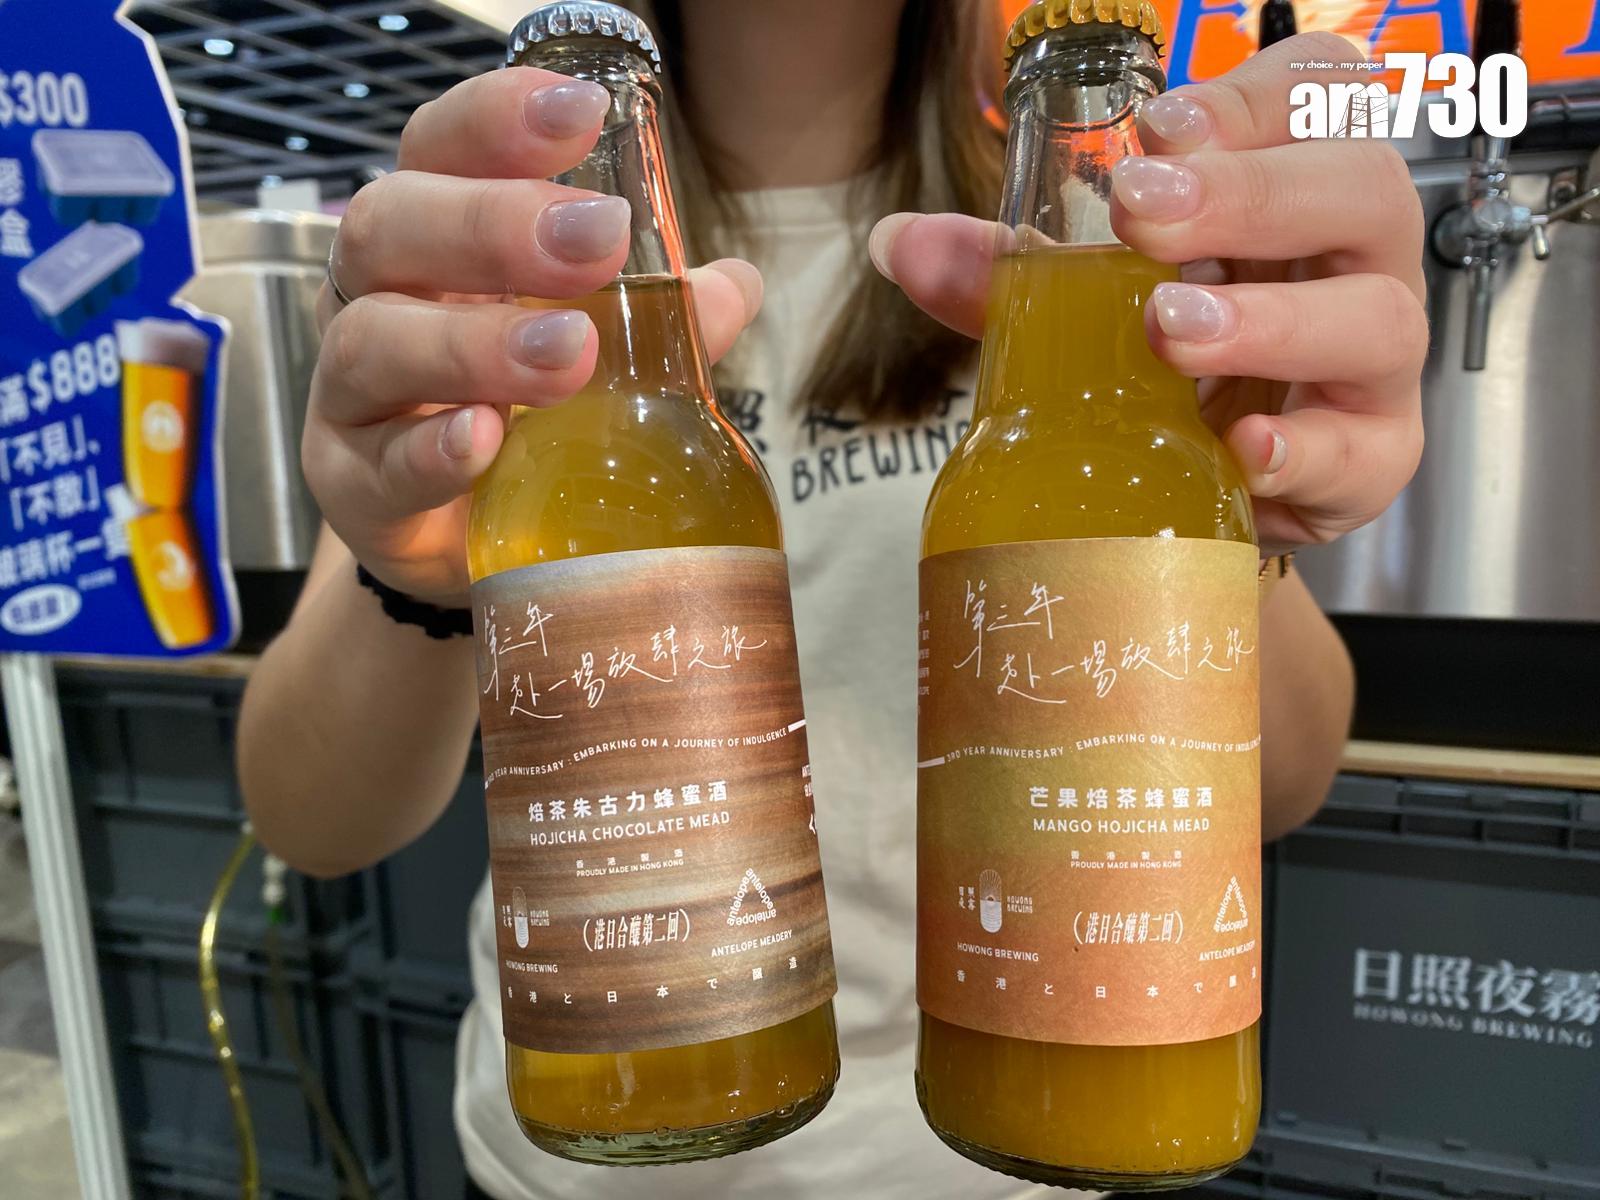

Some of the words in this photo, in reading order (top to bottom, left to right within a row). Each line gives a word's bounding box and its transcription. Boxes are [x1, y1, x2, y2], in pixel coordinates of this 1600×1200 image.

[509, 760, 564, 776] ANNIVERSARY
[574, 738, 636, 762] EMBARKING
[641, 738, 657, 748] ON
[662, 738, 669, 748] A
[674, 738, 724, 748] JOURNEY
[727, 737, 740, 748] OF
[743, 727, 787, 746] INDULGENCE
[963, 746, 986, 756] YEAR
[989, 747, 1063, 759] ANNIVERSARY
[1076, 733, 1145, 750] EMBARKING
[1151, 734, 1165, 744] ON
[1169, 738, 1177, 746] A
[1181, 739, 1221, 752] JOURNEY
[1225, 743, 1234, 752] OF
[528, 780, 728, 823] 焙茶朱古力蜂蜜酒
[1029, 786, 1212, 809] 芒果焙茶蜂蜜酒
[530, 830, 587, 846] HOJICHA
[592, 818, 684, 841] CHOCOLATE
[690, 811, 730, 828] MEAD
[1033, 818, 1091, 833] MANGO
[1098, 819, 1168, 833] HOJICHA
[1173, 818, 1209, 832] MEAD
[576, 867, 607, 878] PROUDLY
[608, 865, 629, 875] MADE
[630, 864, 639, 872] IN
[640, 862, 661, 871] HONG
[663, 858, 684, 868] KONG
[1107, 861, 1128, 869] MADE
[1140, 861, 1161, 869] HONG
[711, 939, 758, 957] ANTELOPE
[760, 929, 792, 947] MEADERY
[957, 942, 993, 955] HOWONG
[994, 948, 1039, 962] BREWING
[1199, 947, 1235, 961] ANTELOPE
[526, 963, 559, 974] BREWING
[1354, 948, 1600, 1026] 日照夜霧
[1353, 1003, 1463, 1031] HOWONG
[1471, 1016, 1593, 1049] BREWING
